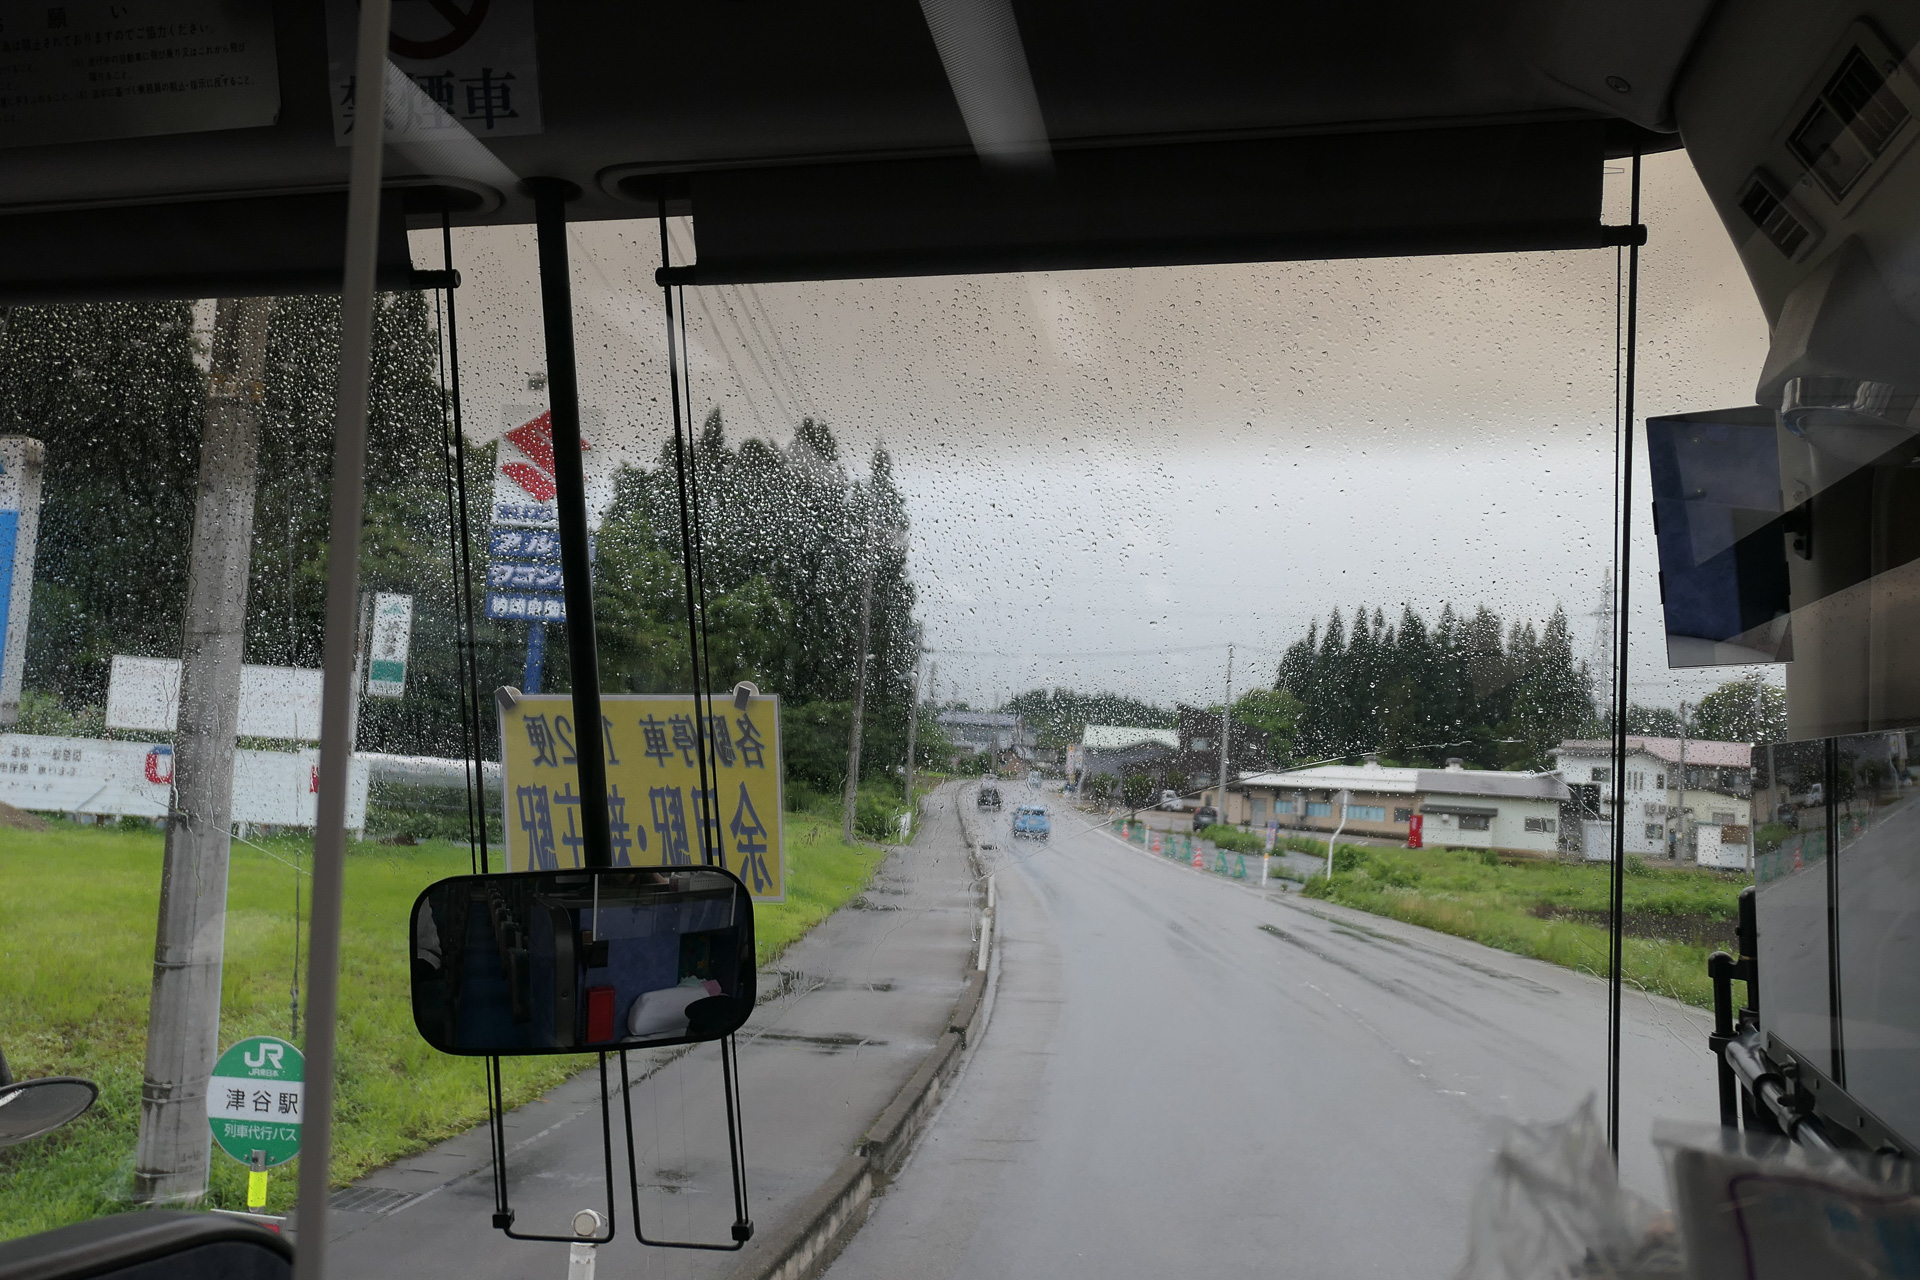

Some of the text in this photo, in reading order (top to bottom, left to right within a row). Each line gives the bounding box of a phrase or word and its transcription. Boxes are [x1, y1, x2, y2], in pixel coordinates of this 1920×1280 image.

[244, 1042, 284, 1069] JR
[225, 1088, 298, 1115] 津谷駅
[223, 1123, 297, 1142] 列車代行バス
